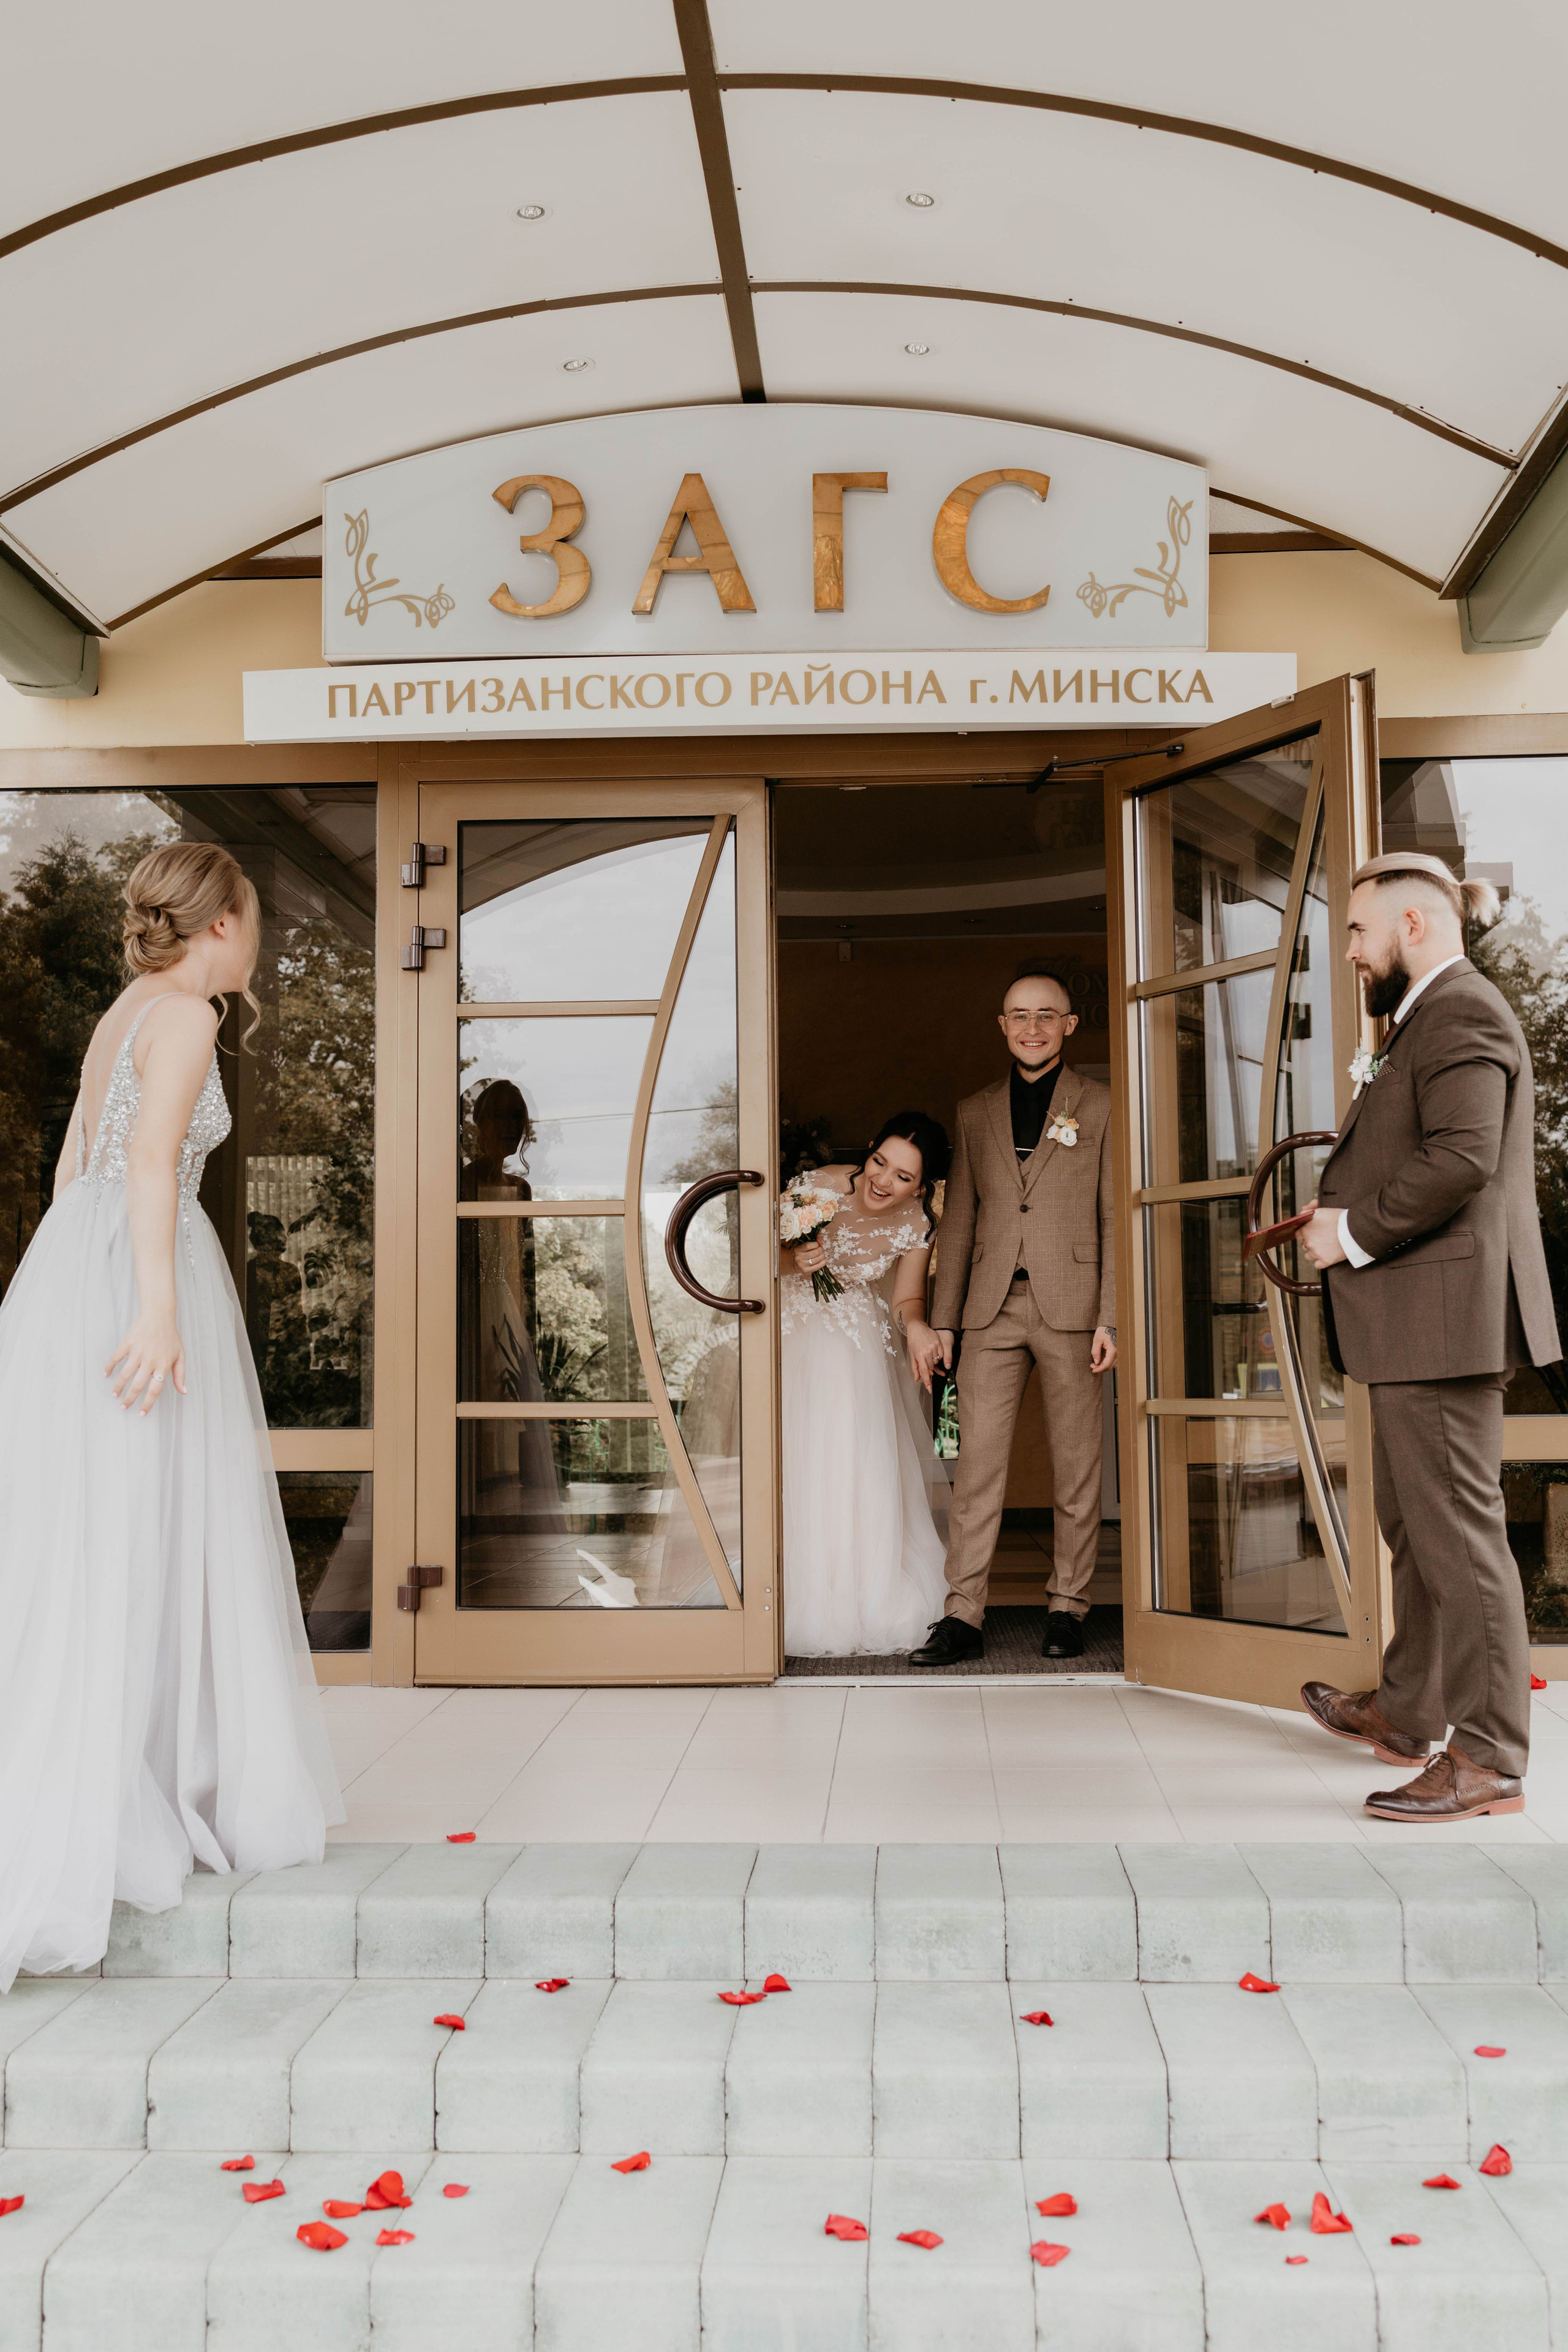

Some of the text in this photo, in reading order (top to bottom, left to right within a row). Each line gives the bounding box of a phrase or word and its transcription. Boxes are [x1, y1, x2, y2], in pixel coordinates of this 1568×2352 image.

[488, 468, 1052, 620] ЗАГС
[328, 672, 732, 718] ПАРТИЗАНСКОГО
[750, 663, 947, 706] РАЙОНА
